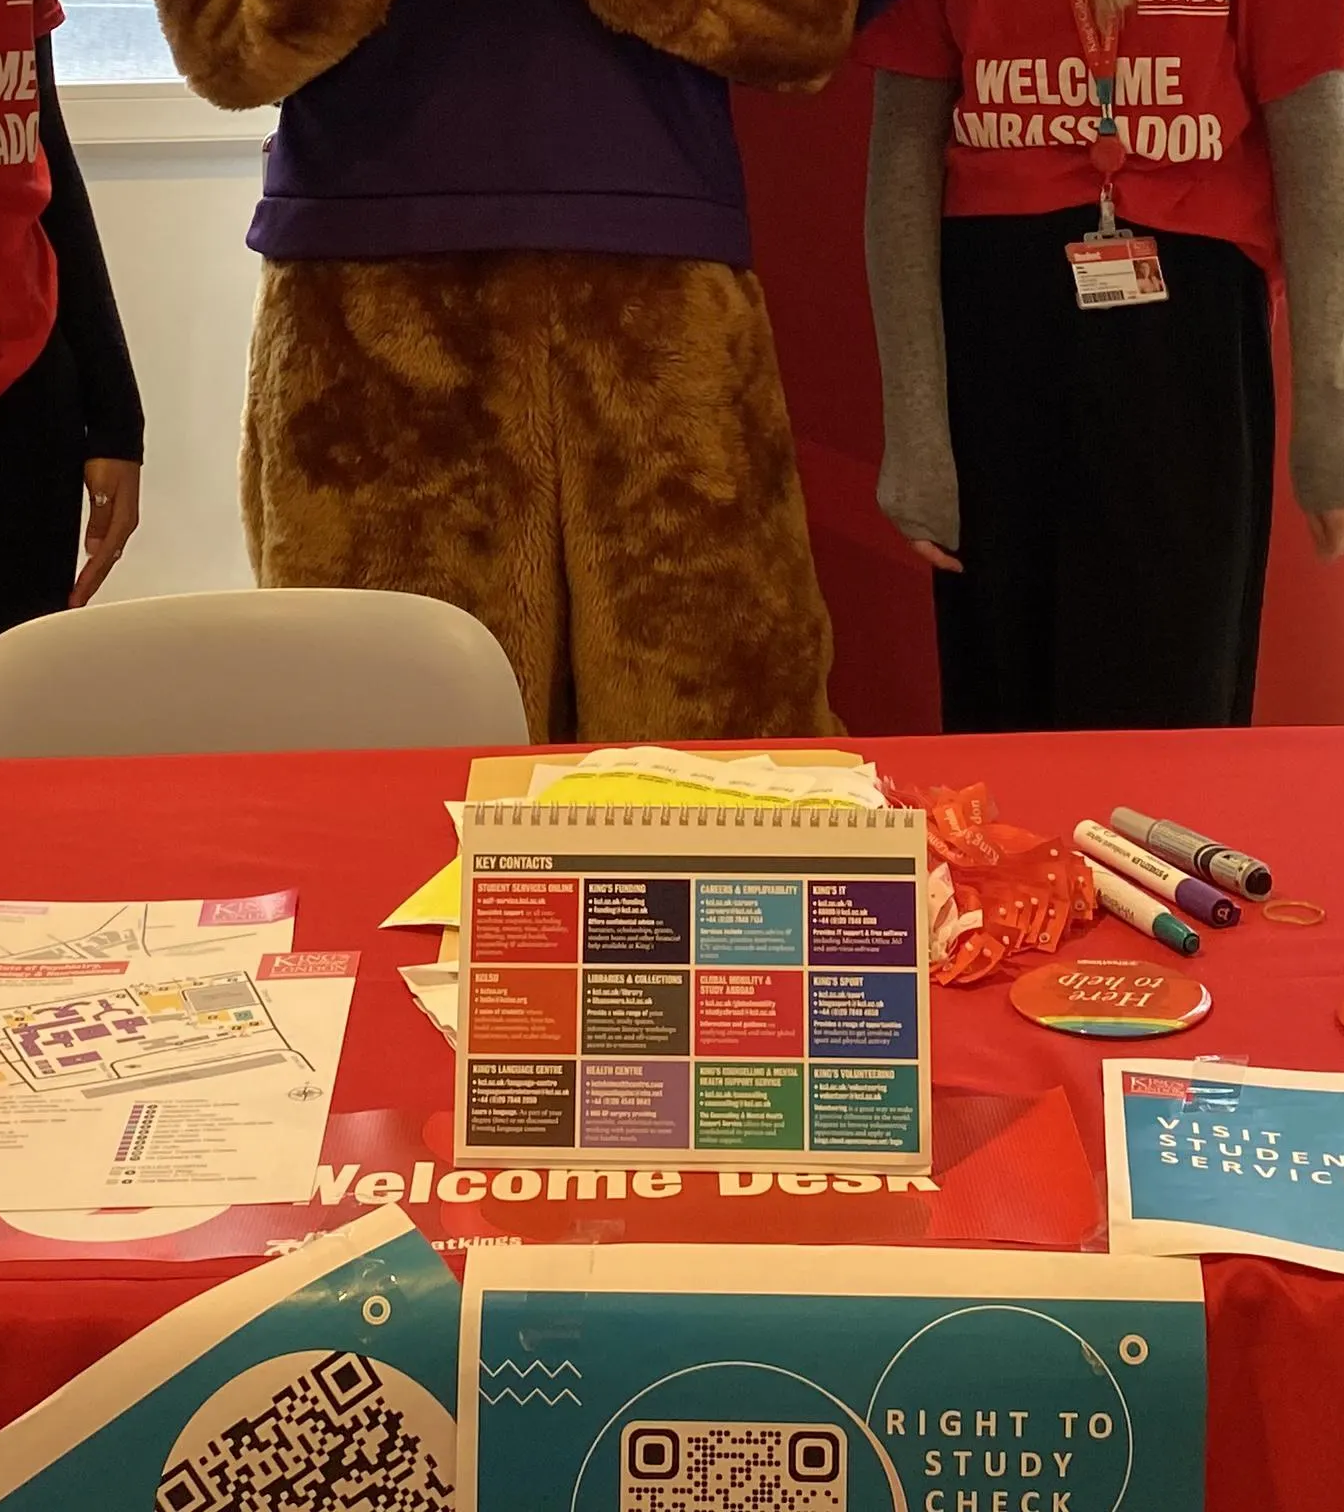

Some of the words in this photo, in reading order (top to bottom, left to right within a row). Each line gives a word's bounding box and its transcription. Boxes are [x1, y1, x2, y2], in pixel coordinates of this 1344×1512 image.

[475, 856, 497, 869] KEY
[499, 856, 553, 870] CONTACTS
[589, 884, 613, 893] KING'S
[615, 884, 646, 893] FUNDING
[700, 885, 733, 894] CAREERS
[735, 885, 741, 894] &
[743, 885, 798, 895] EMPLOYABILITY
[813, 886, 837, 895] KING'S
[839, 886, 846, 895] IT
[588, 974, 625, 983] LIBRARIES
[626, 974, 633, 984] &
[635, 975, 682, 984] COLLECTIONS
[700, 975, 727, 984] GLOBAL
[729, 976, 763, 985] MOBILITY
[765, 976, 771, 985] &
[813, 977, 838, 986] KING'S
[840, 977, 863, 986] SPORT
[1057, 972, 1126, 991] help
[1133, 975, 1165, 990] to
[700, 986, 724, 994] STUDY
[726, 986, 755, 995] ABROAD
[1068, 990, 1155, 1008] Here
[473, 1065, 496, 1074] KING'S
[498, 1065, 534, 1074] LANGUAGE
[536, 1065, 563, 1074] CENTRE
[586, 1066, 613, 1075] HEALTH
[615, 1066, 643, 1075] CENTRE
[814, 1069, 839, 1078] KING'S
[840, 1070, 895, 1079] VOLUNTEERING
[1156, 1116, 1282, 1146] VISIT
[886, 1408, 1029, 1438] RIGHT
[1059, 1411, 1114, 1439] TO
[925, 1450, 1075, 1478] STUDY
